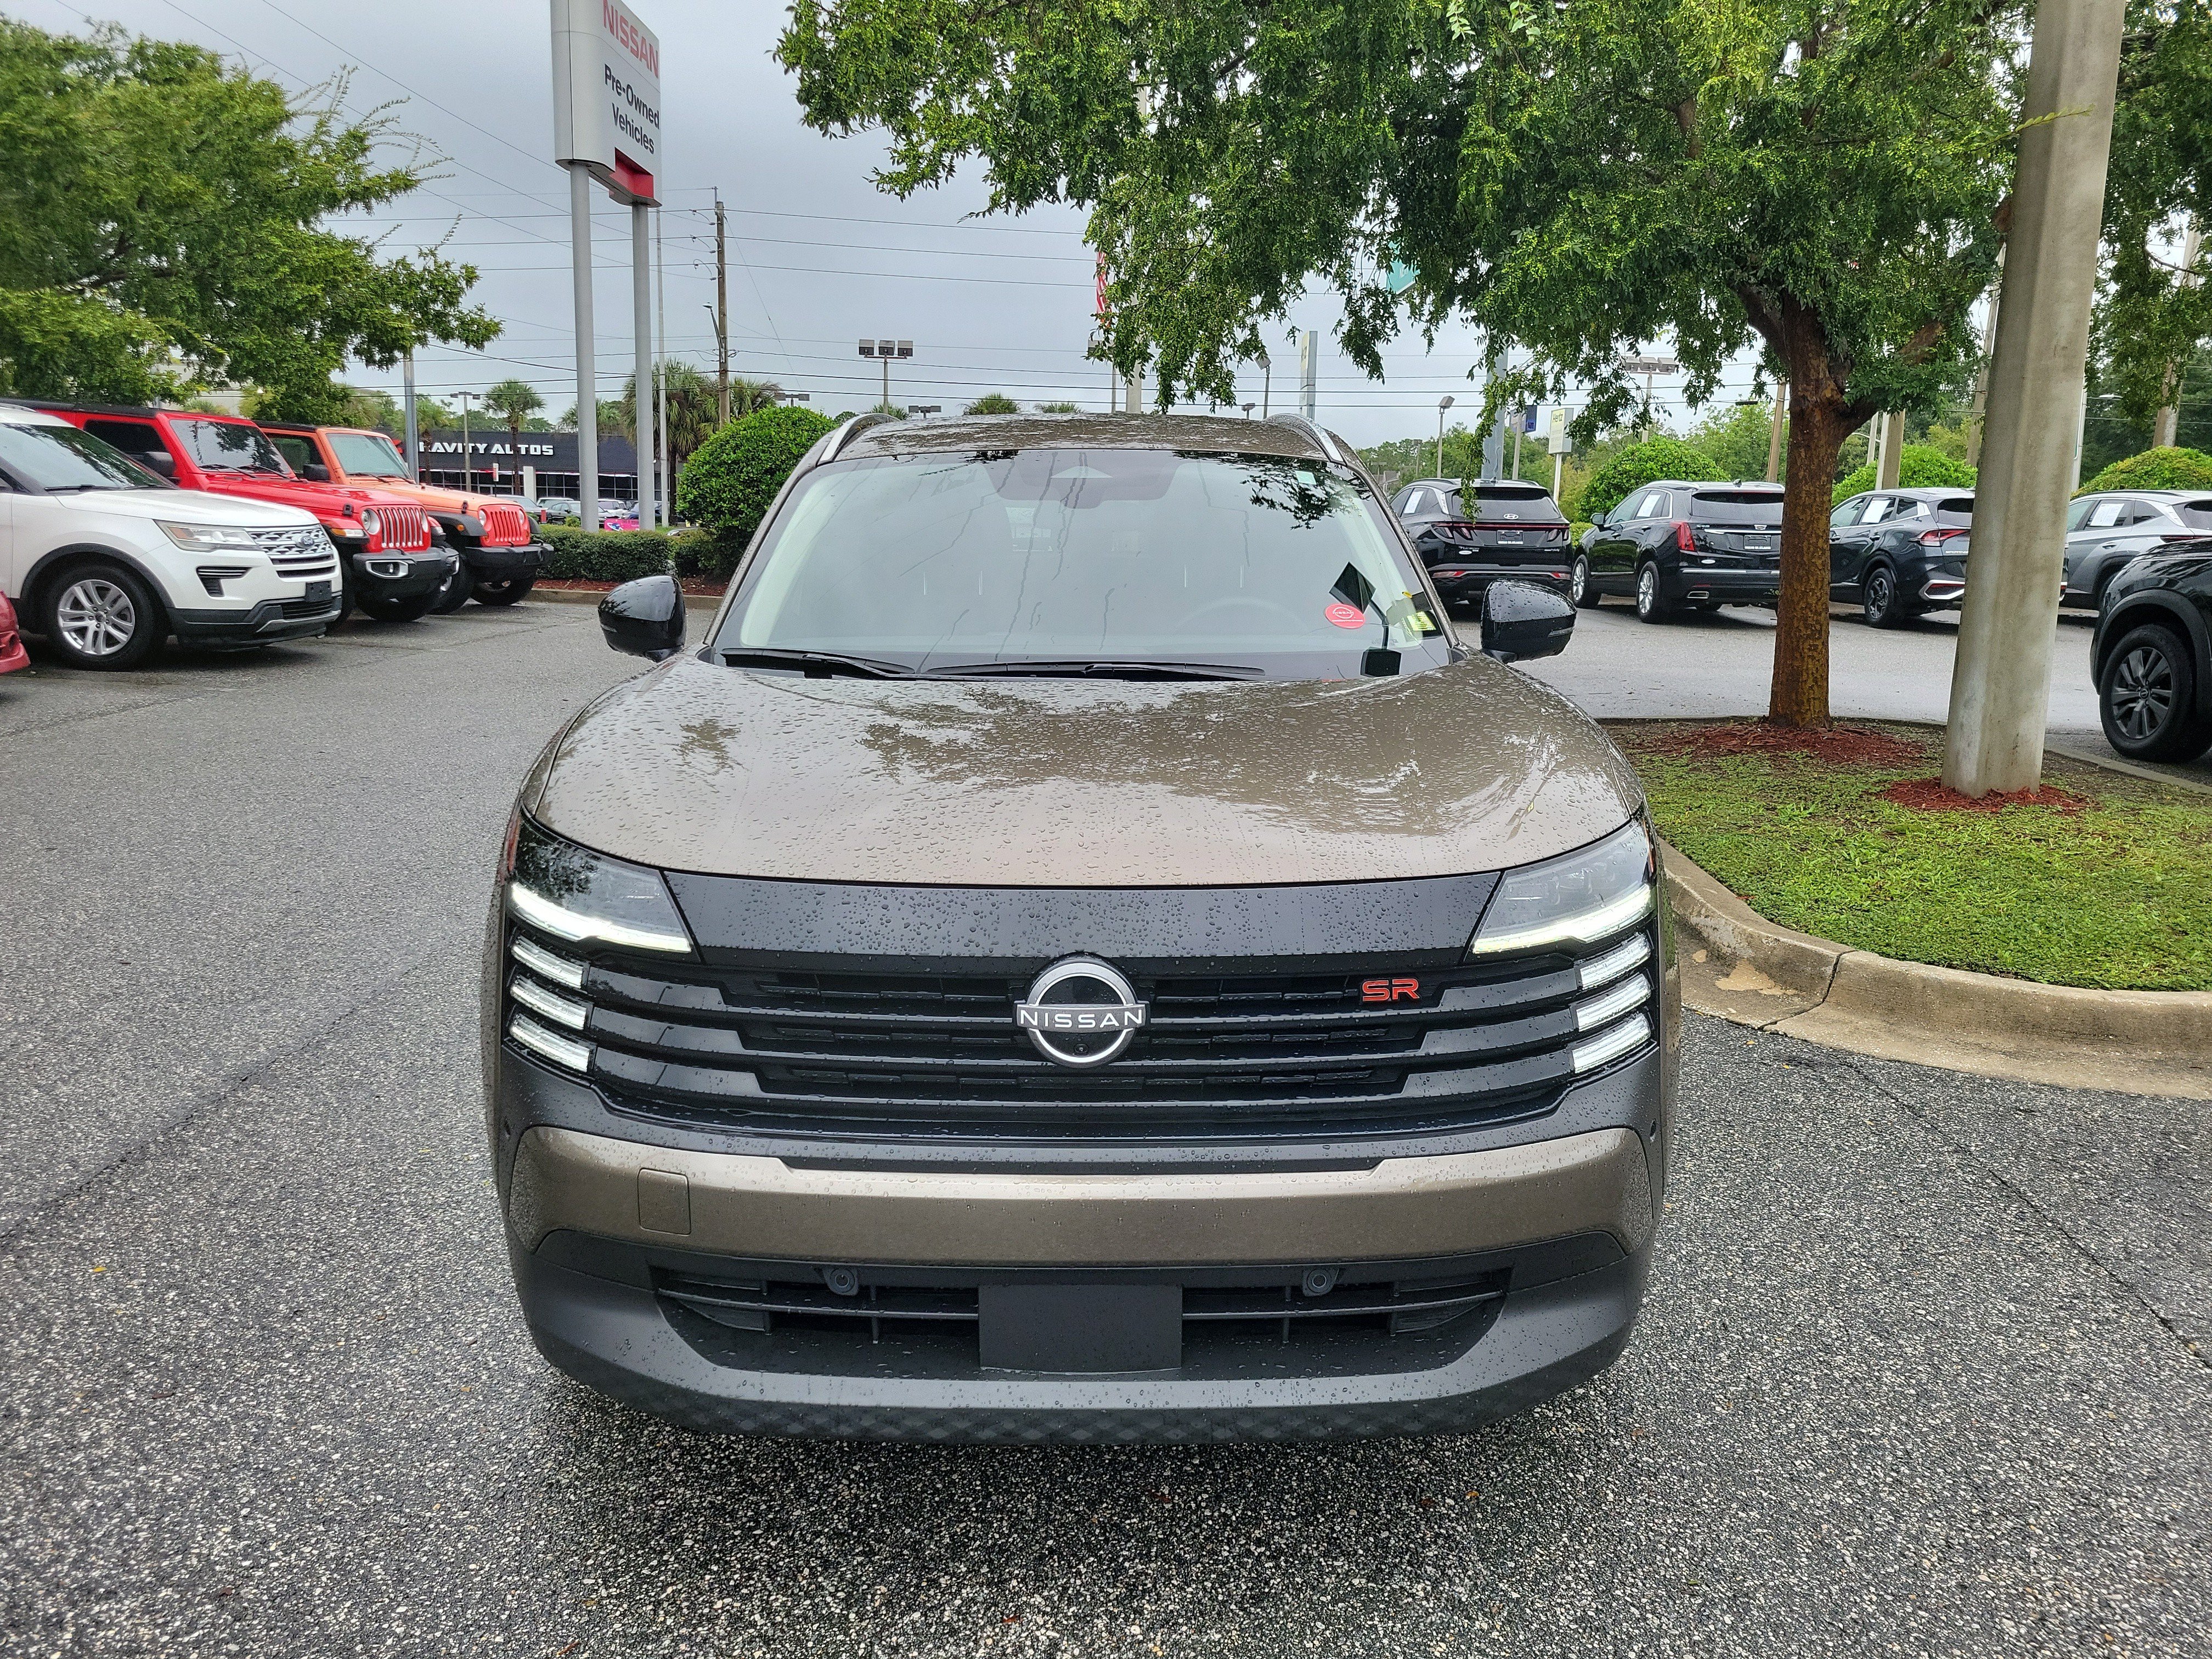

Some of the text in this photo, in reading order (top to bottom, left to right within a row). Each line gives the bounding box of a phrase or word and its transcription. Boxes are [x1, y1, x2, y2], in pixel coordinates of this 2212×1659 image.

[603, 0, 658, 78] NISSAN
[605, 64, 659, 129] Pre-Owned
[612, 103, 654, 154] Vehicles
[1362, 978, 1420, 1002] SR
[1020, 1009, 1142, 1028] NISSAN
